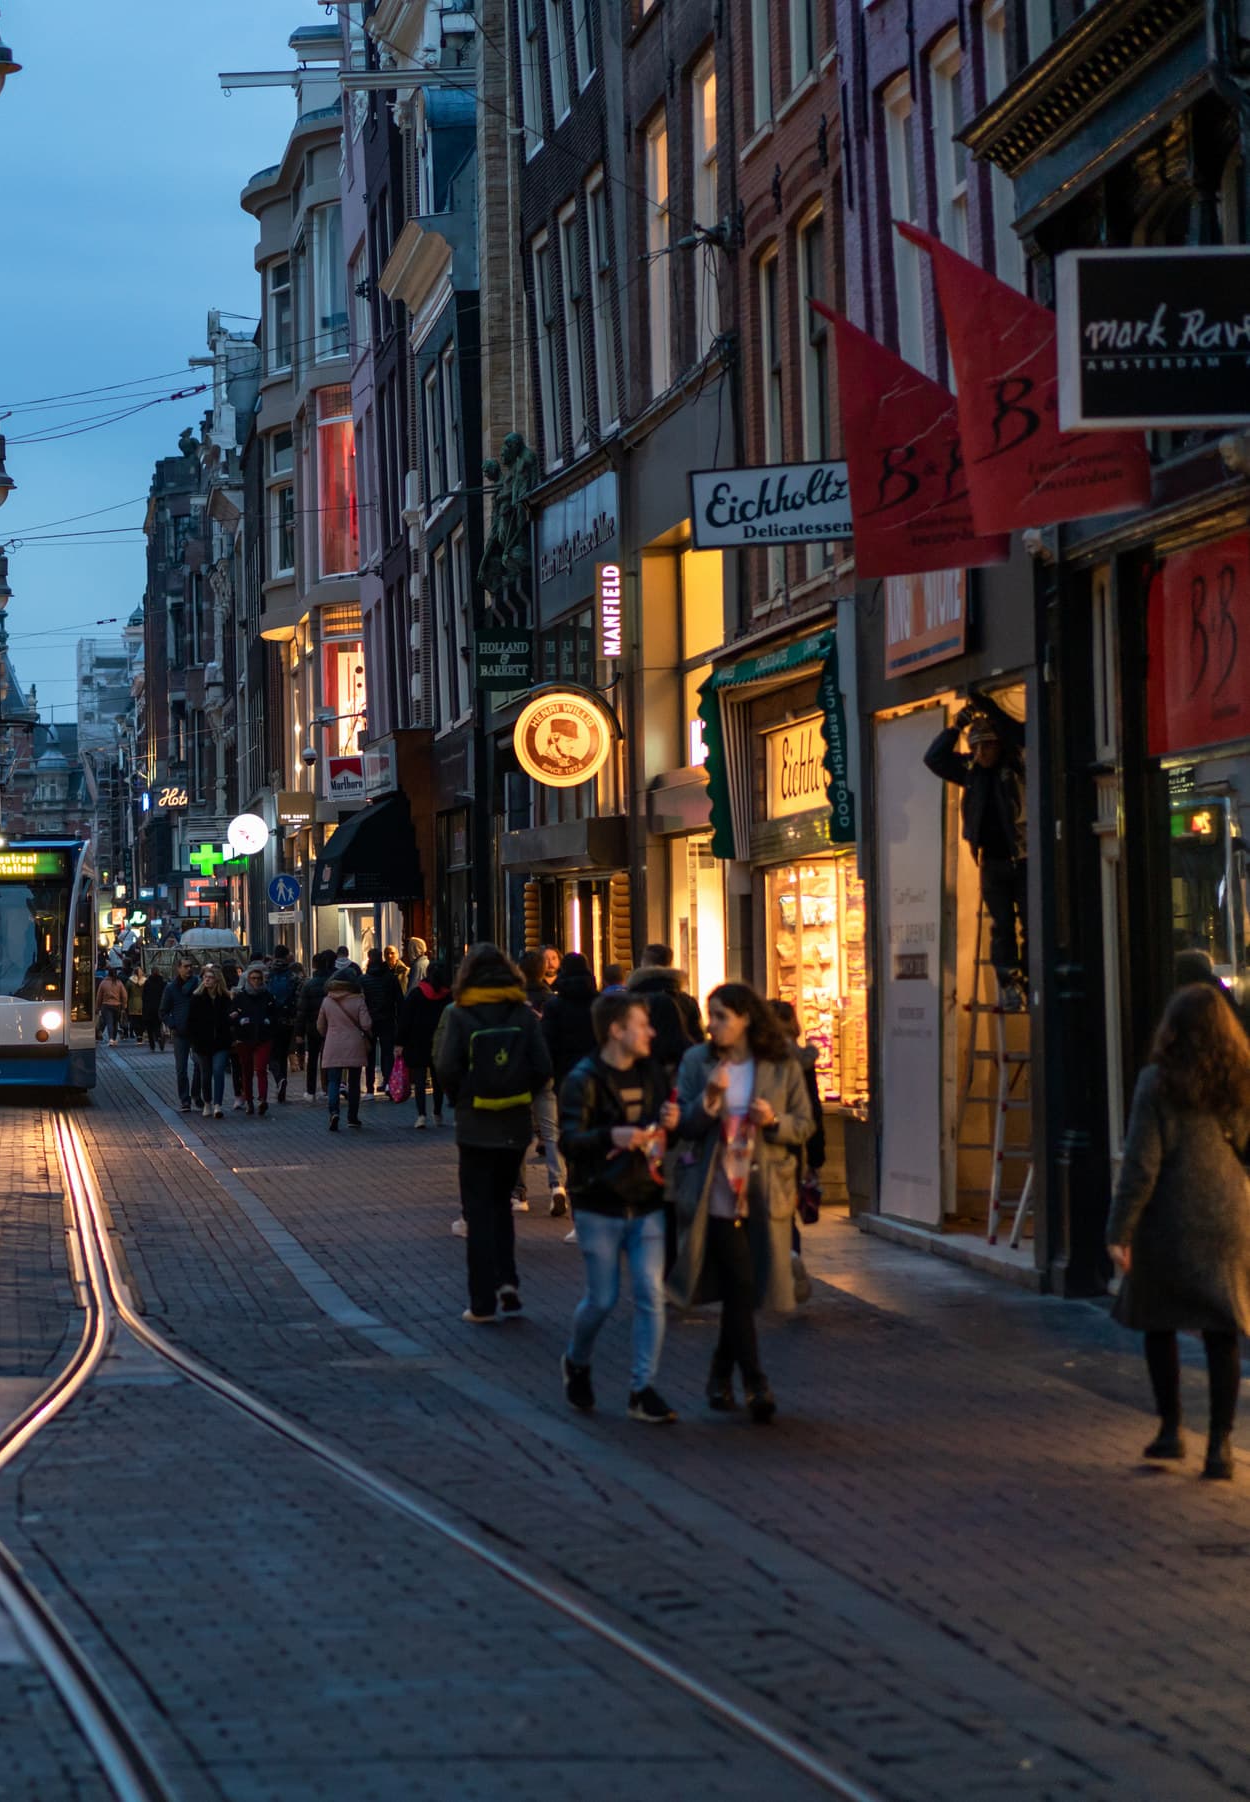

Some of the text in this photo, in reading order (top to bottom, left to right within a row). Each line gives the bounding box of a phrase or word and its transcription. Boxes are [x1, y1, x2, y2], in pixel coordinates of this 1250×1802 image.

[1087, 357, 1220, 371] AMSTERDAM
[706, 469, 848, 528] Eichholtz
[743, 521, 853, 539] Delicatessen
[603, 565, 621, 656] MANFIELD
[479, 642, 529, 654] HOLLAND
[480, 664, 528, 676] BARRETT
[531, 704, 595, 728] HENRI WILLIG
[823, 675, 850, 828] AND BRITISH FOOD
[331, 776, 362, 791] Marlboro
